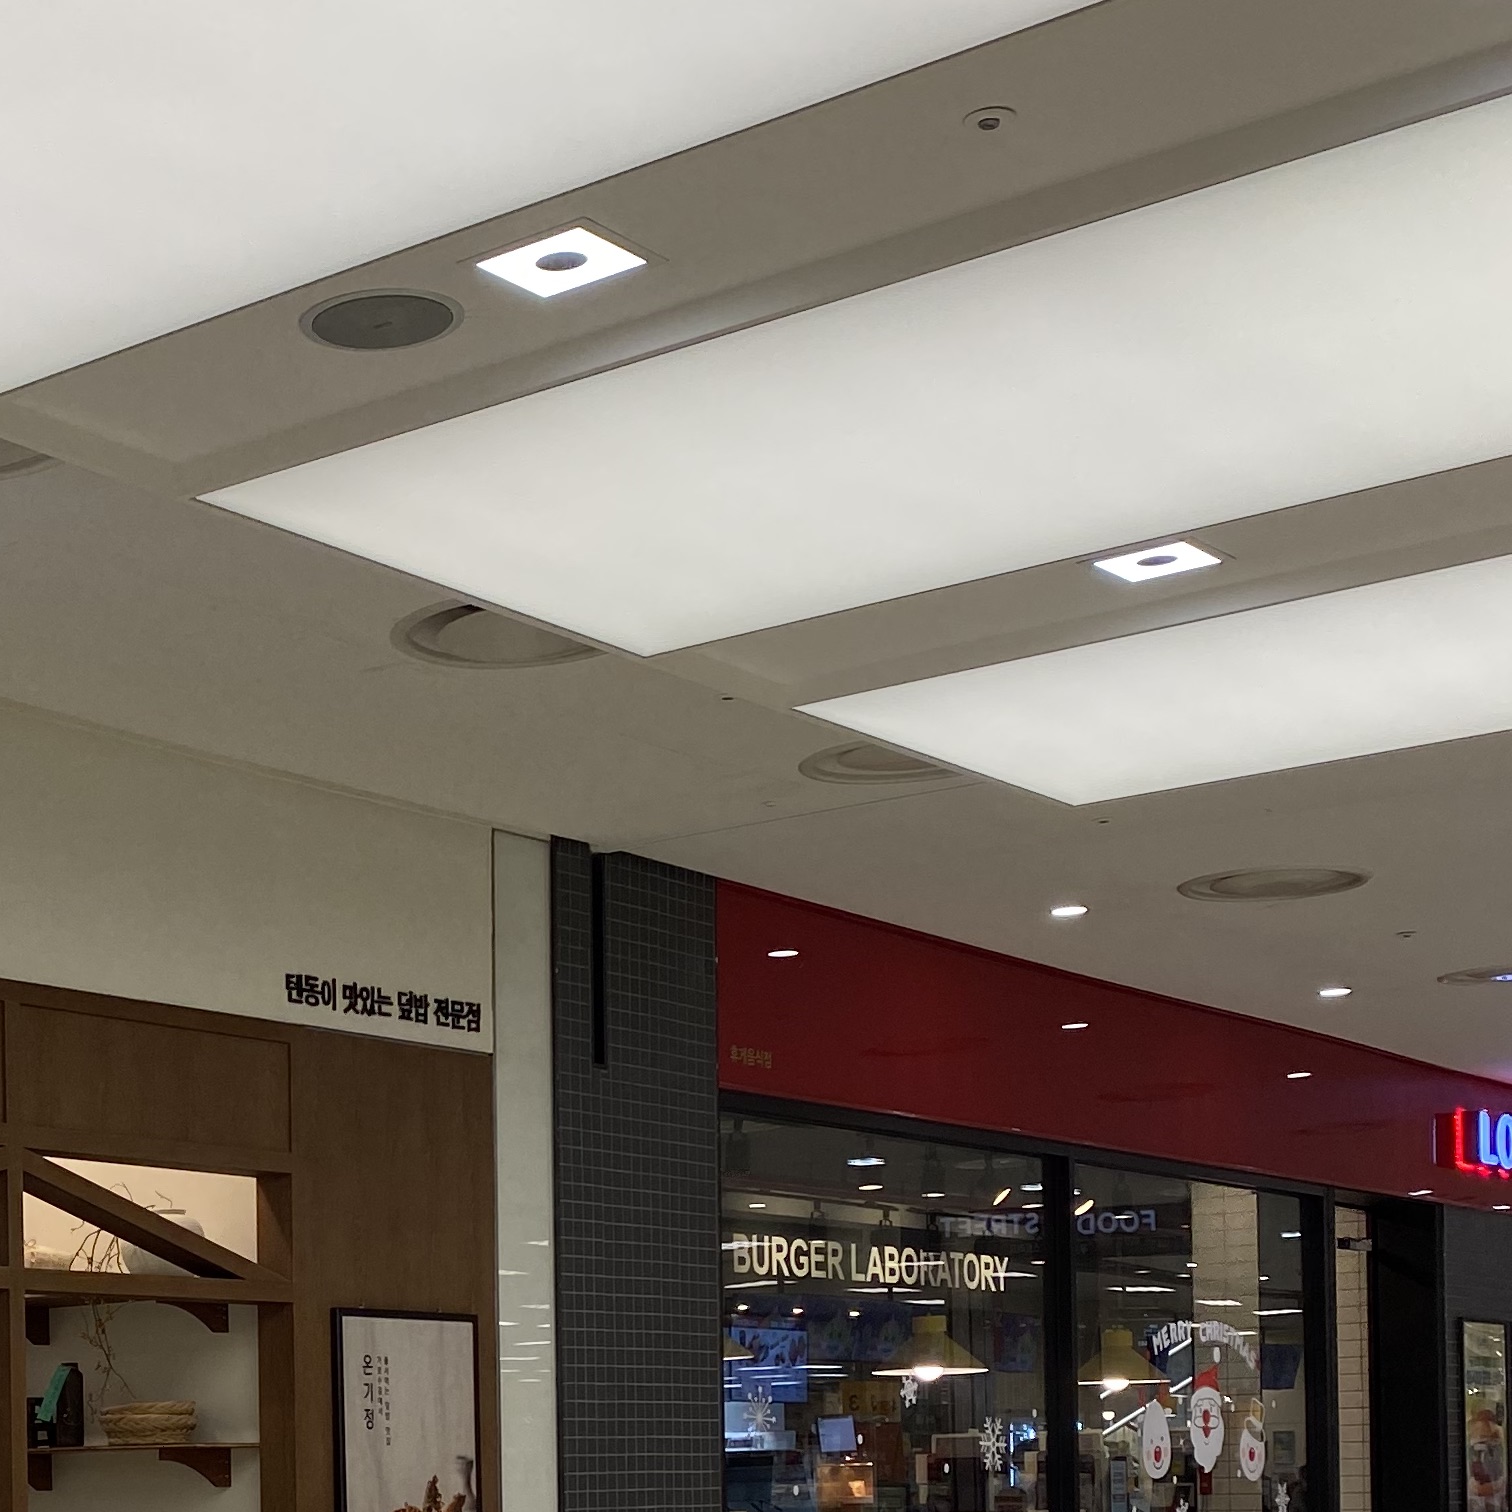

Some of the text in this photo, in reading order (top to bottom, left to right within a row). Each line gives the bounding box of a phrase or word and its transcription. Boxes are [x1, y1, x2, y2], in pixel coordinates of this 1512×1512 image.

[342, 981, 394, 1017] 맛있는
[397, 990, 430, 1025] 덮밥
[433, 997, 481, 1033] 전문점
[730, 1044, 772, 1069] 휴게음식점
[732, 1233, 1009, 1292] BURGER LABORATORY
[1152, 1320, 1258, 1370] MERRY CHRISTMAS
[362, 1354, 374, 1430] 온기정
